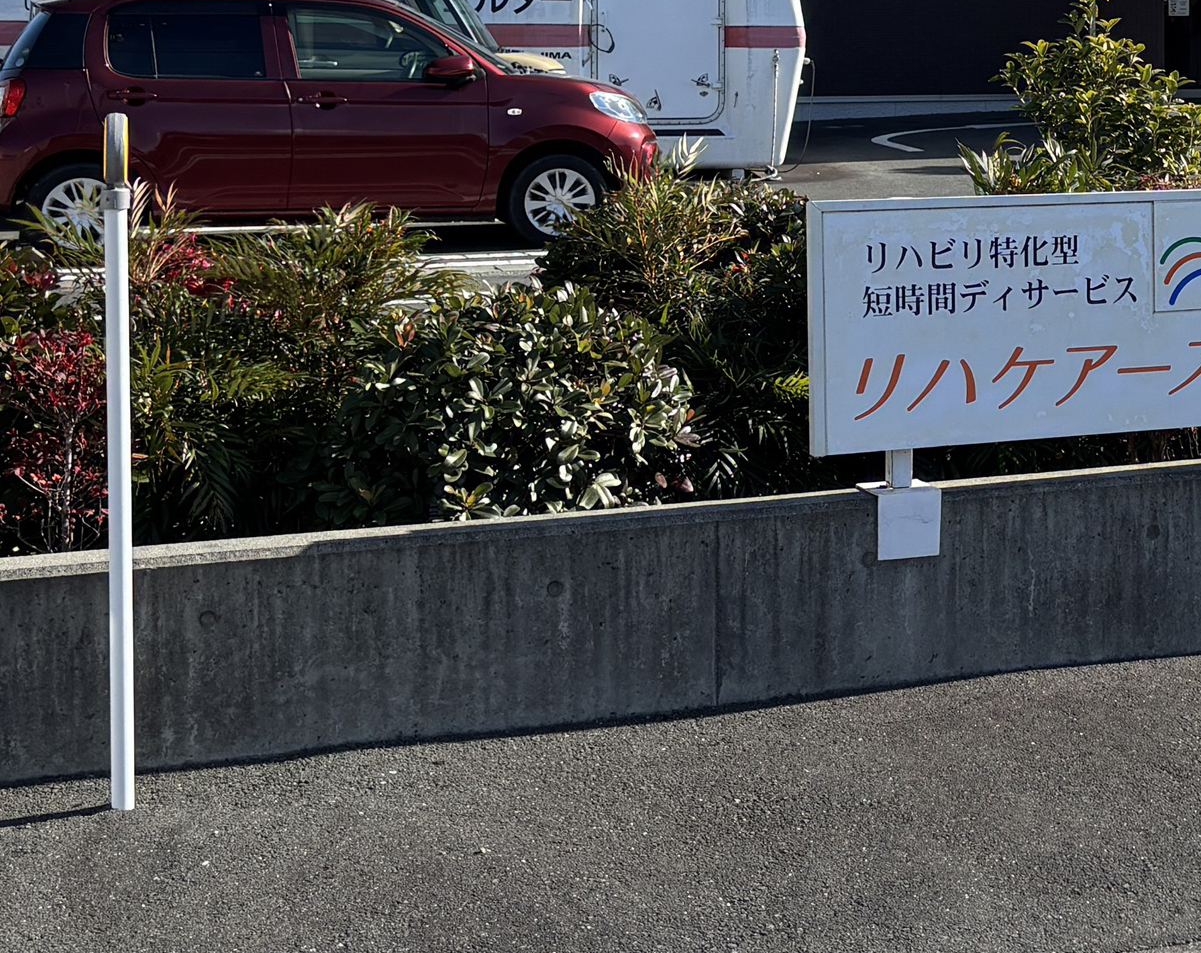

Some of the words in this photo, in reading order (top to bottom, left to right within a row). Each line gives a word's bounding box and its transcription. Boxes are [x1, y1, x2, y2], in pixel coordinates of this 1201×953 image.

[866, 234, 1080, 274] リハビリ特化型
[862, 274, 1139, 319] 短時間ディサービス
